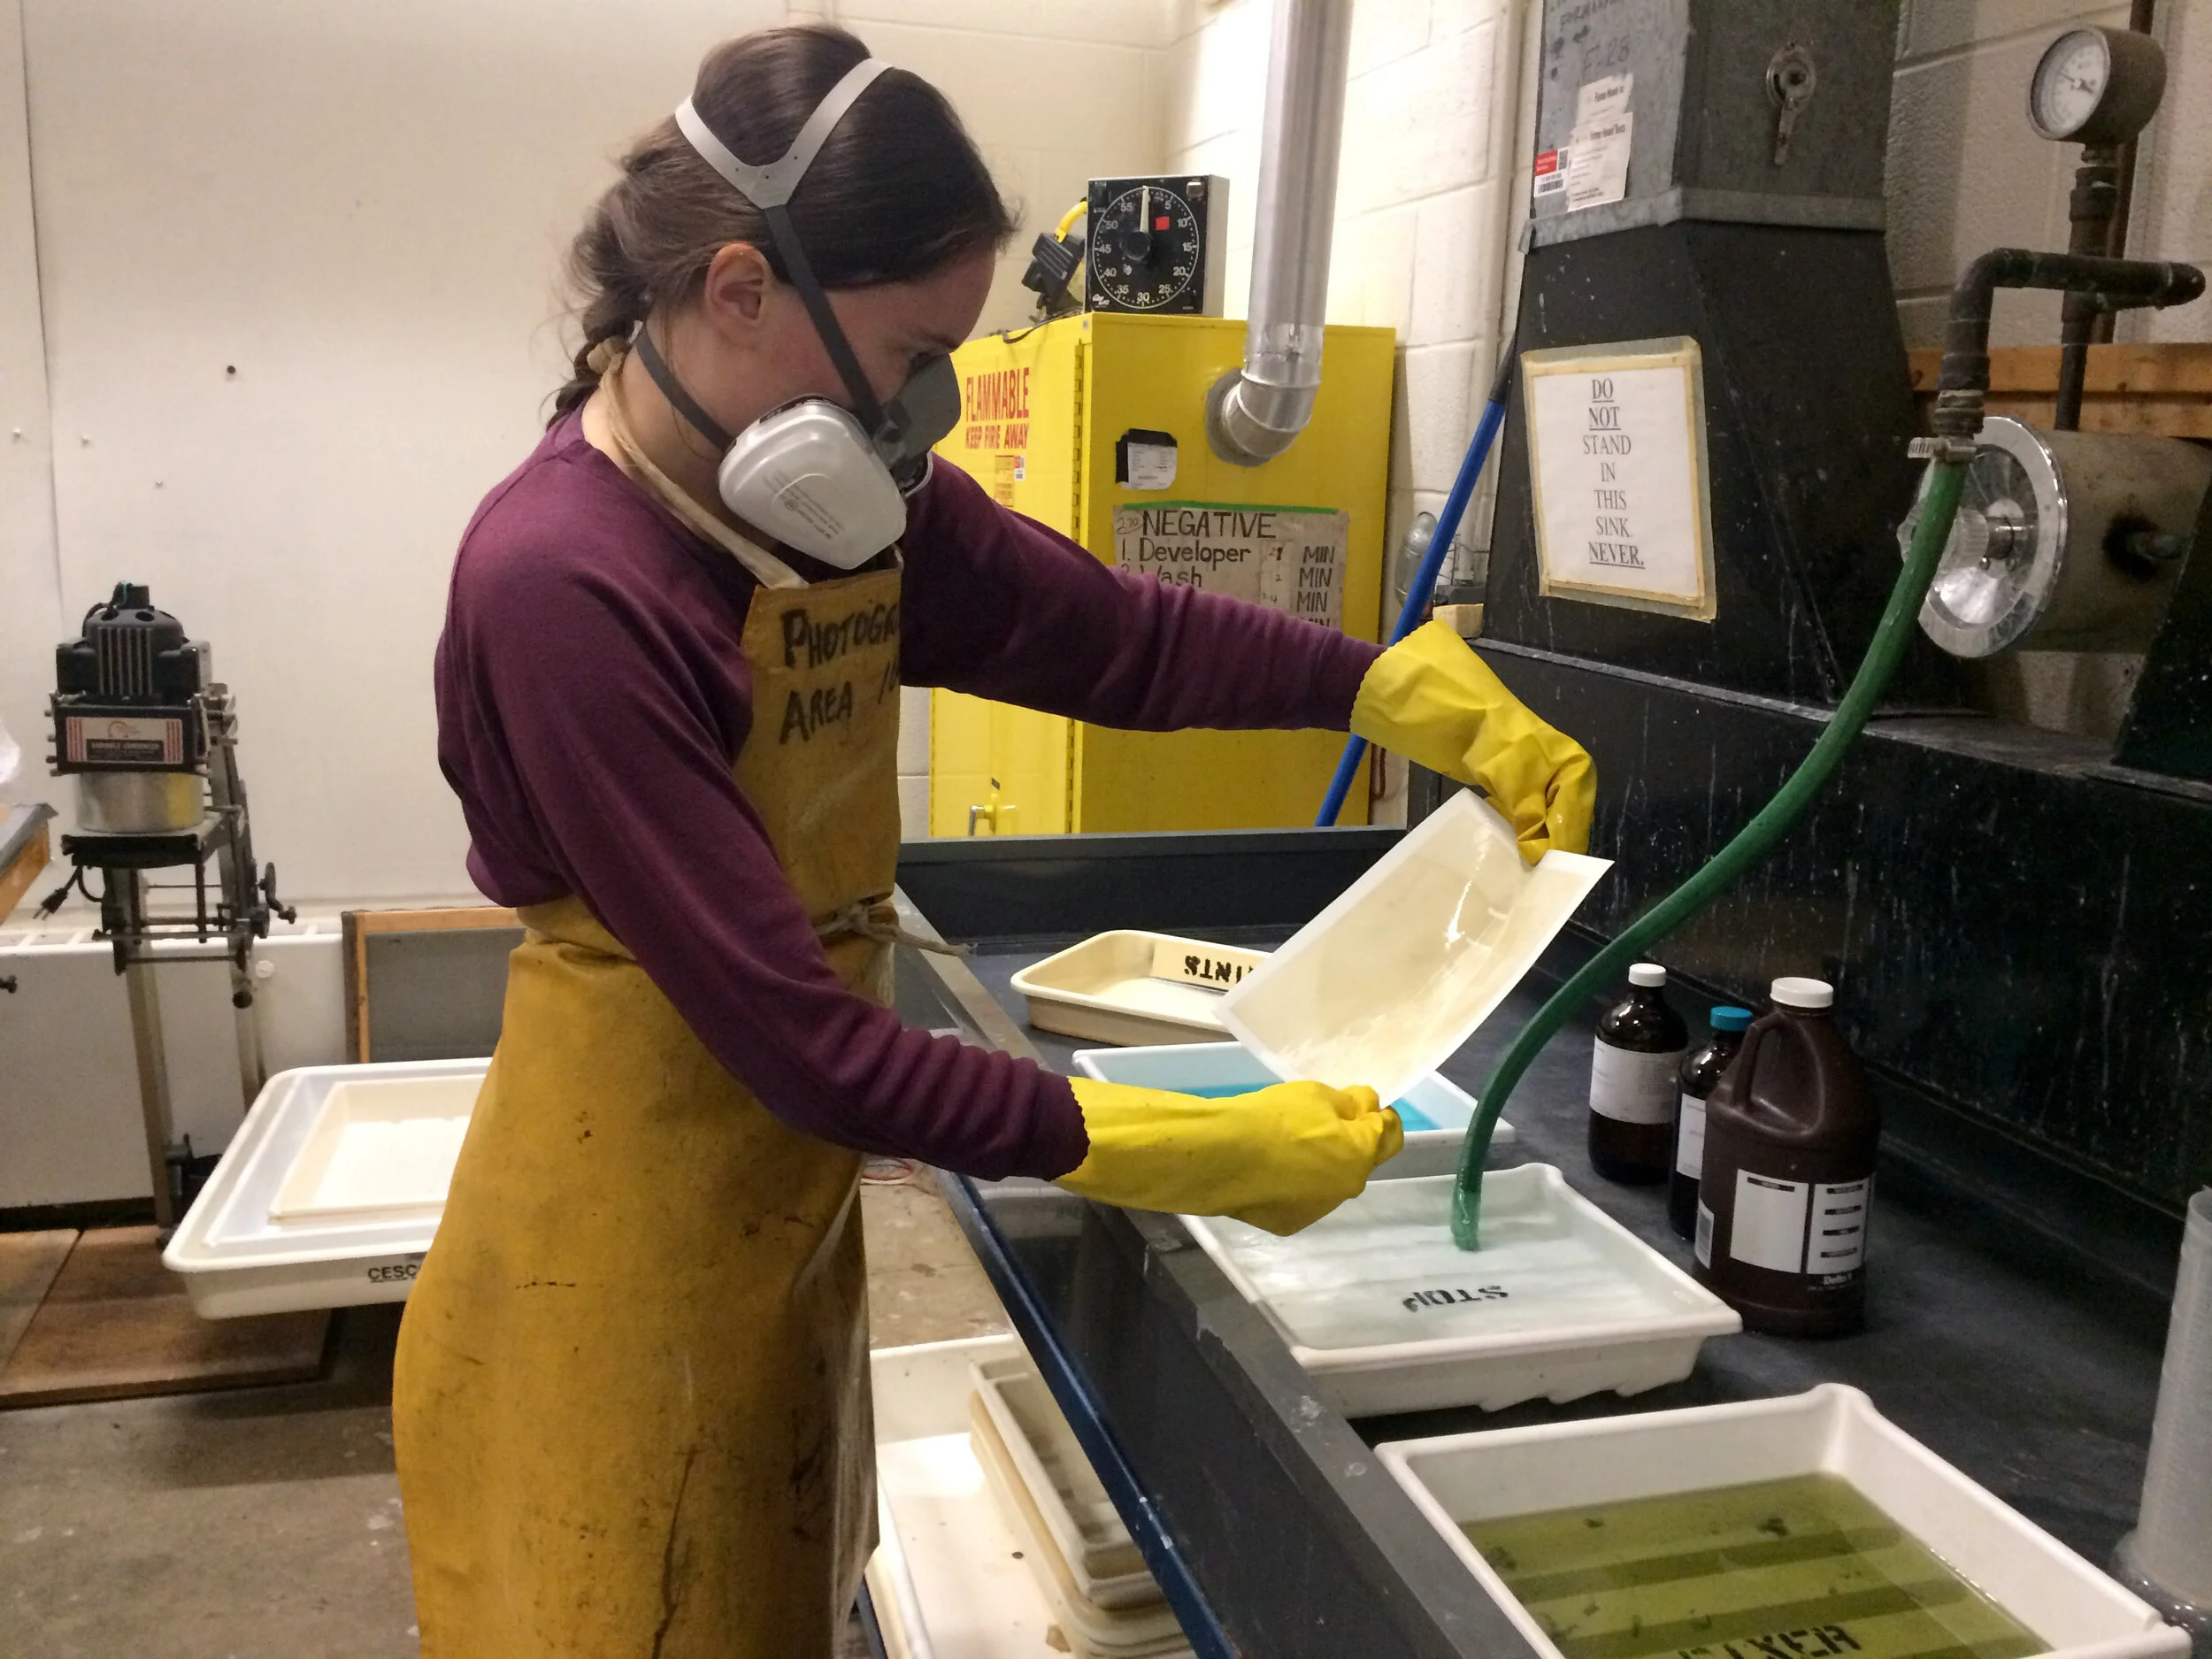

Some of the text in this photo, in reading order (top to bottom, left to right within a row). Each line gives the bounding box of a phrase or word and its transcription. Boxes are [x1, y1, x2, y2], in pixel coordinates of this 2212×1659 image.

[1120, 202, 1133, 211] 55
[1106, 220, 1118, 229] 50
[1178, 219, 1187, 227] 10
[1100, 244, 1111, 253] 45
[1182, 242, 1192, 251] 15
[1104, 268, 1117, 277] 40
[1173, 266, 1186, 276] 20
[1118, 285, 1129, 294] 35
[1137, 292, 1150, 302] 30
[1158, 284, 1171, 294] 25
[966, 367, 1029, 422] FLAMMABLE
[1592, 378, 1614, 401] DO
[1589, 406, 1620, 428] NOT
[965, 423, 1029, 449] KEEP FIRE AWAY
[1583, 434, 1632, 455] STAND
[1601, 462, 1616, 482] IN
[1594, 489, 1627, 511] THIS
[1142, 510, 1277, 539] NEGATIVE
[1139, 537, 1251, 571] Developer
[1302, 546, 1335, 564] MIN
[1588, 541, 1645, 567] NEVER.
[1299, 567, 1333, 588] MIN
[1296, 591, 1328, 612] MIN
[780, 680, 854, 745] AREA
[1184, 955, 1254, 984] INTS
[368, 1263, 421, 1280] CESC
[1402, 1286, 1509, 1313] STOP
